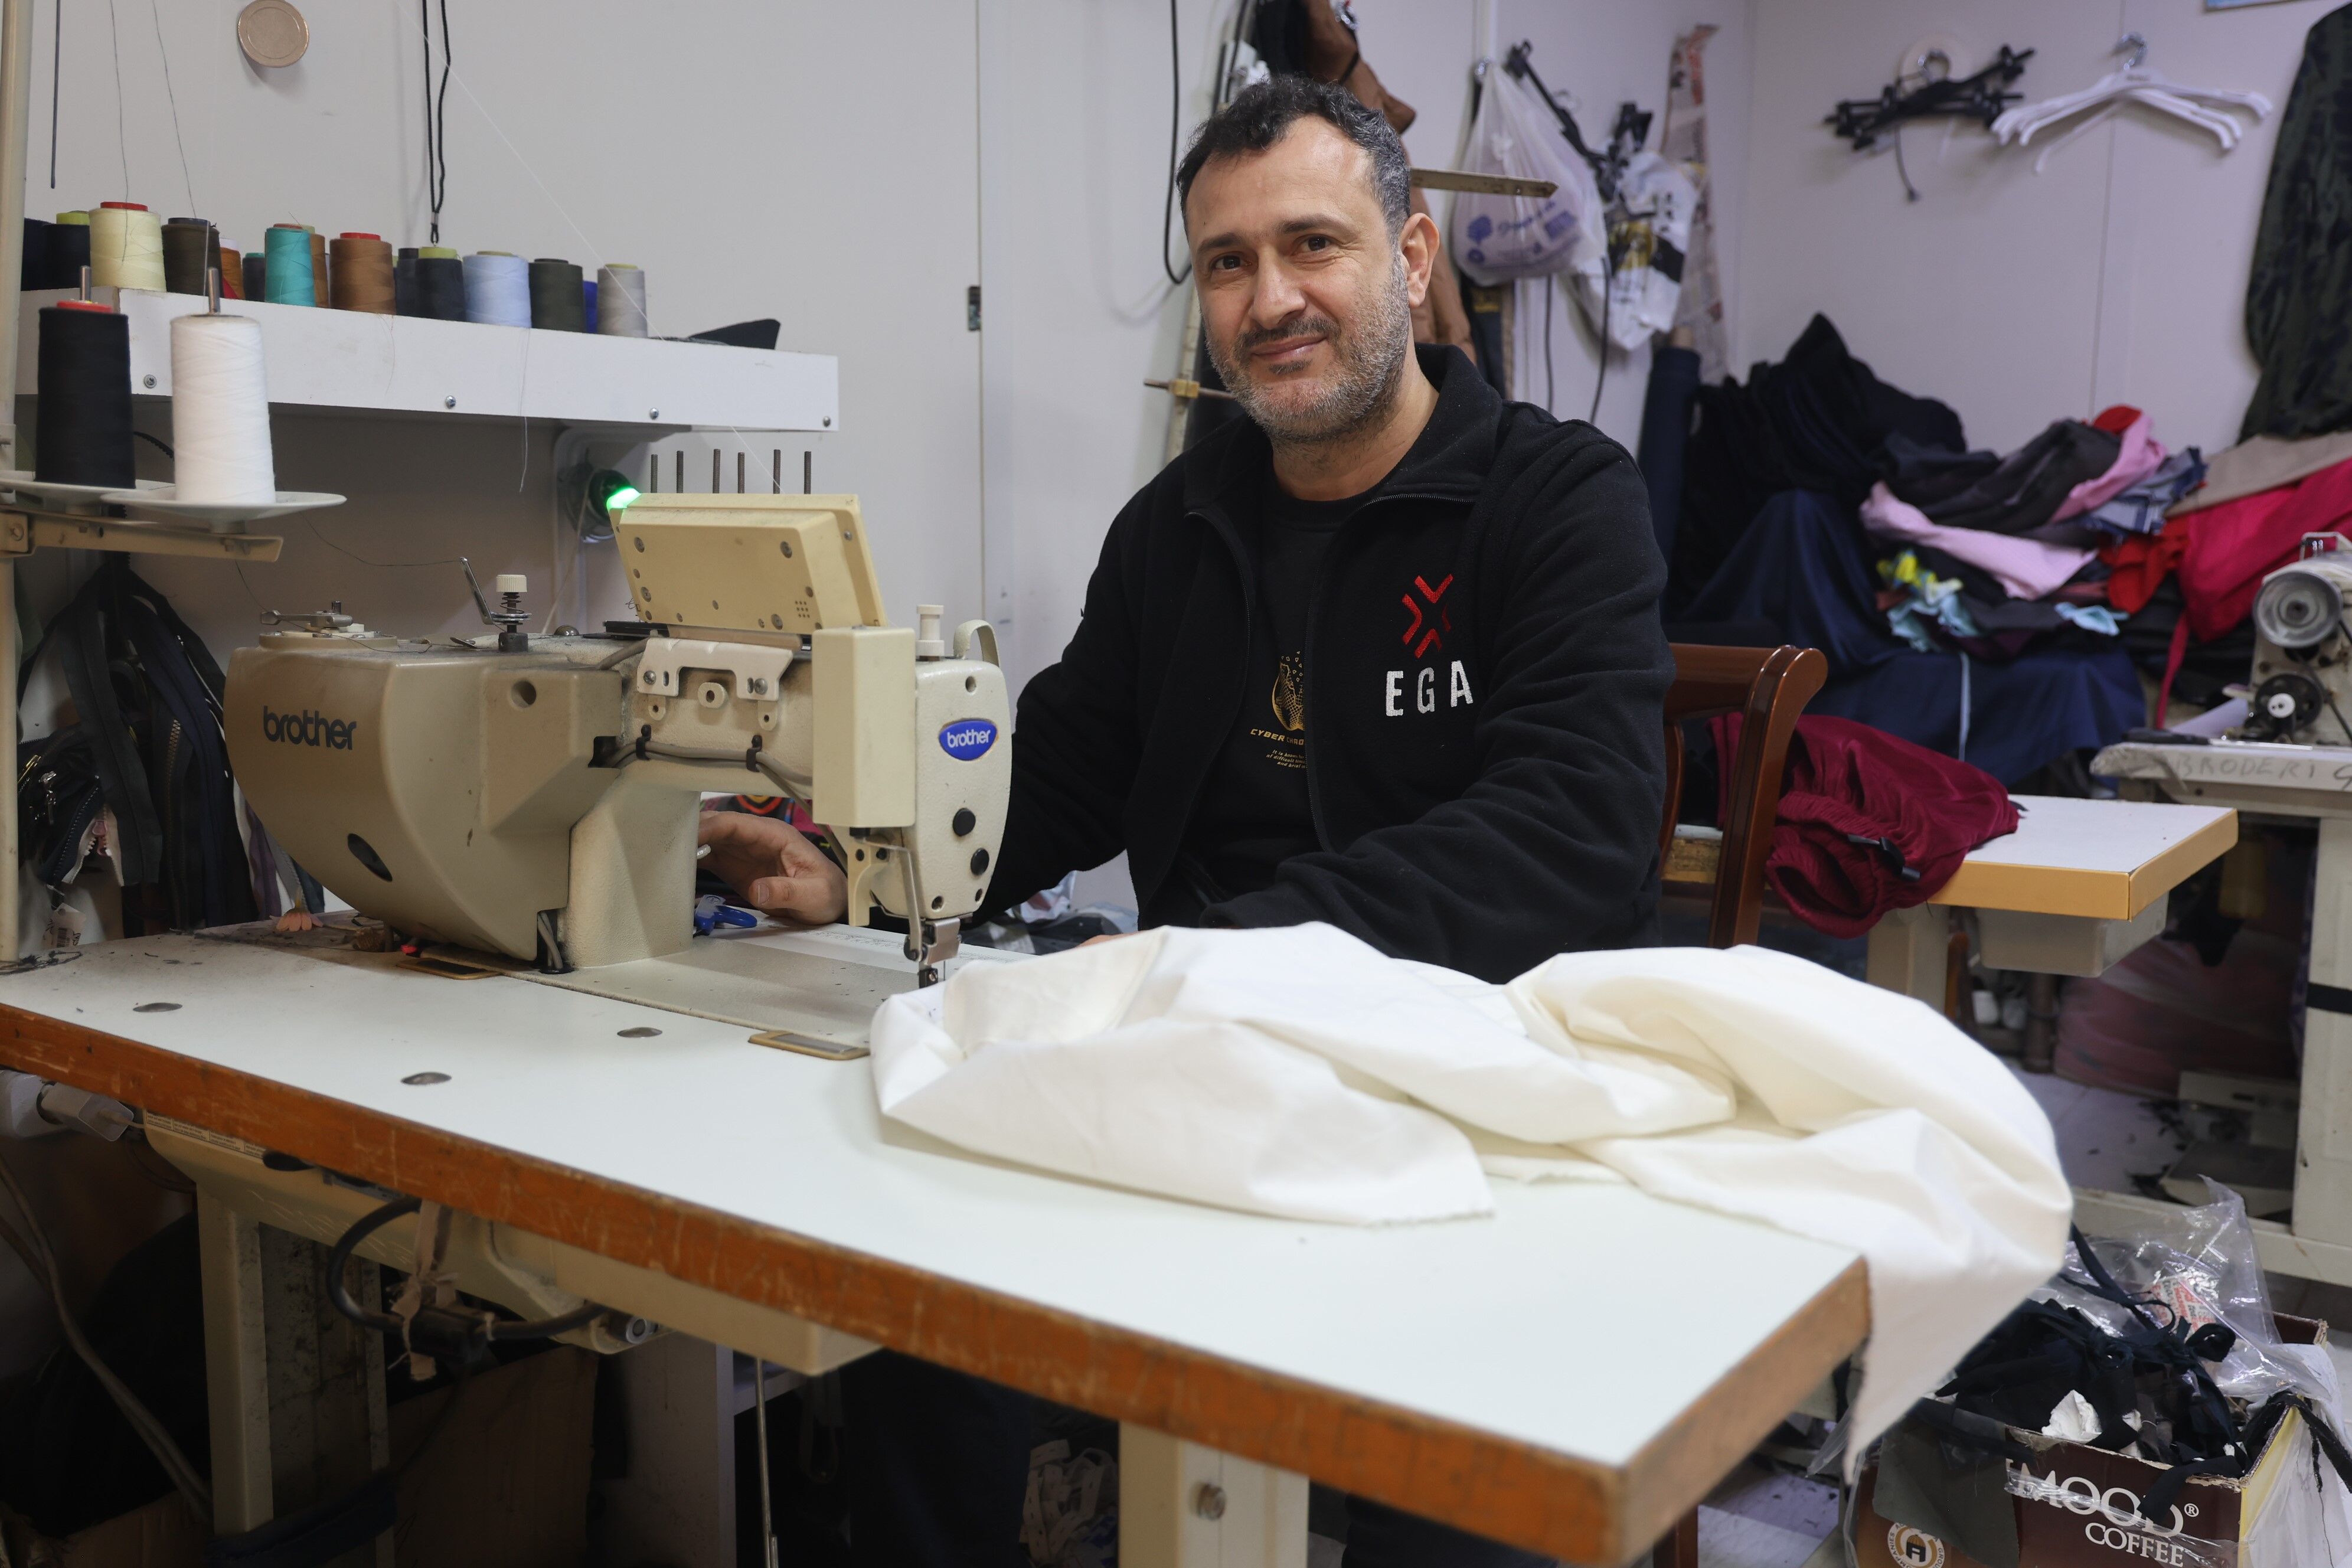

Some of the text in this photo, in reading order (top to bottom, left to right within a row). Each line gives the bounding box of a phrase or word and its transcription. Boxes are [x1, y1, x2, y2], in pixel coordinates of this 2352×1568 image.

[1385, 659, 1474, 717] EGA
[263, 704, 357, 751] brother
[946, 729, 991, 749] brother
[1250, 729, 1304, 746] CYBER CHAO
[2085, 1522, 2184, 1567] COFFEE
